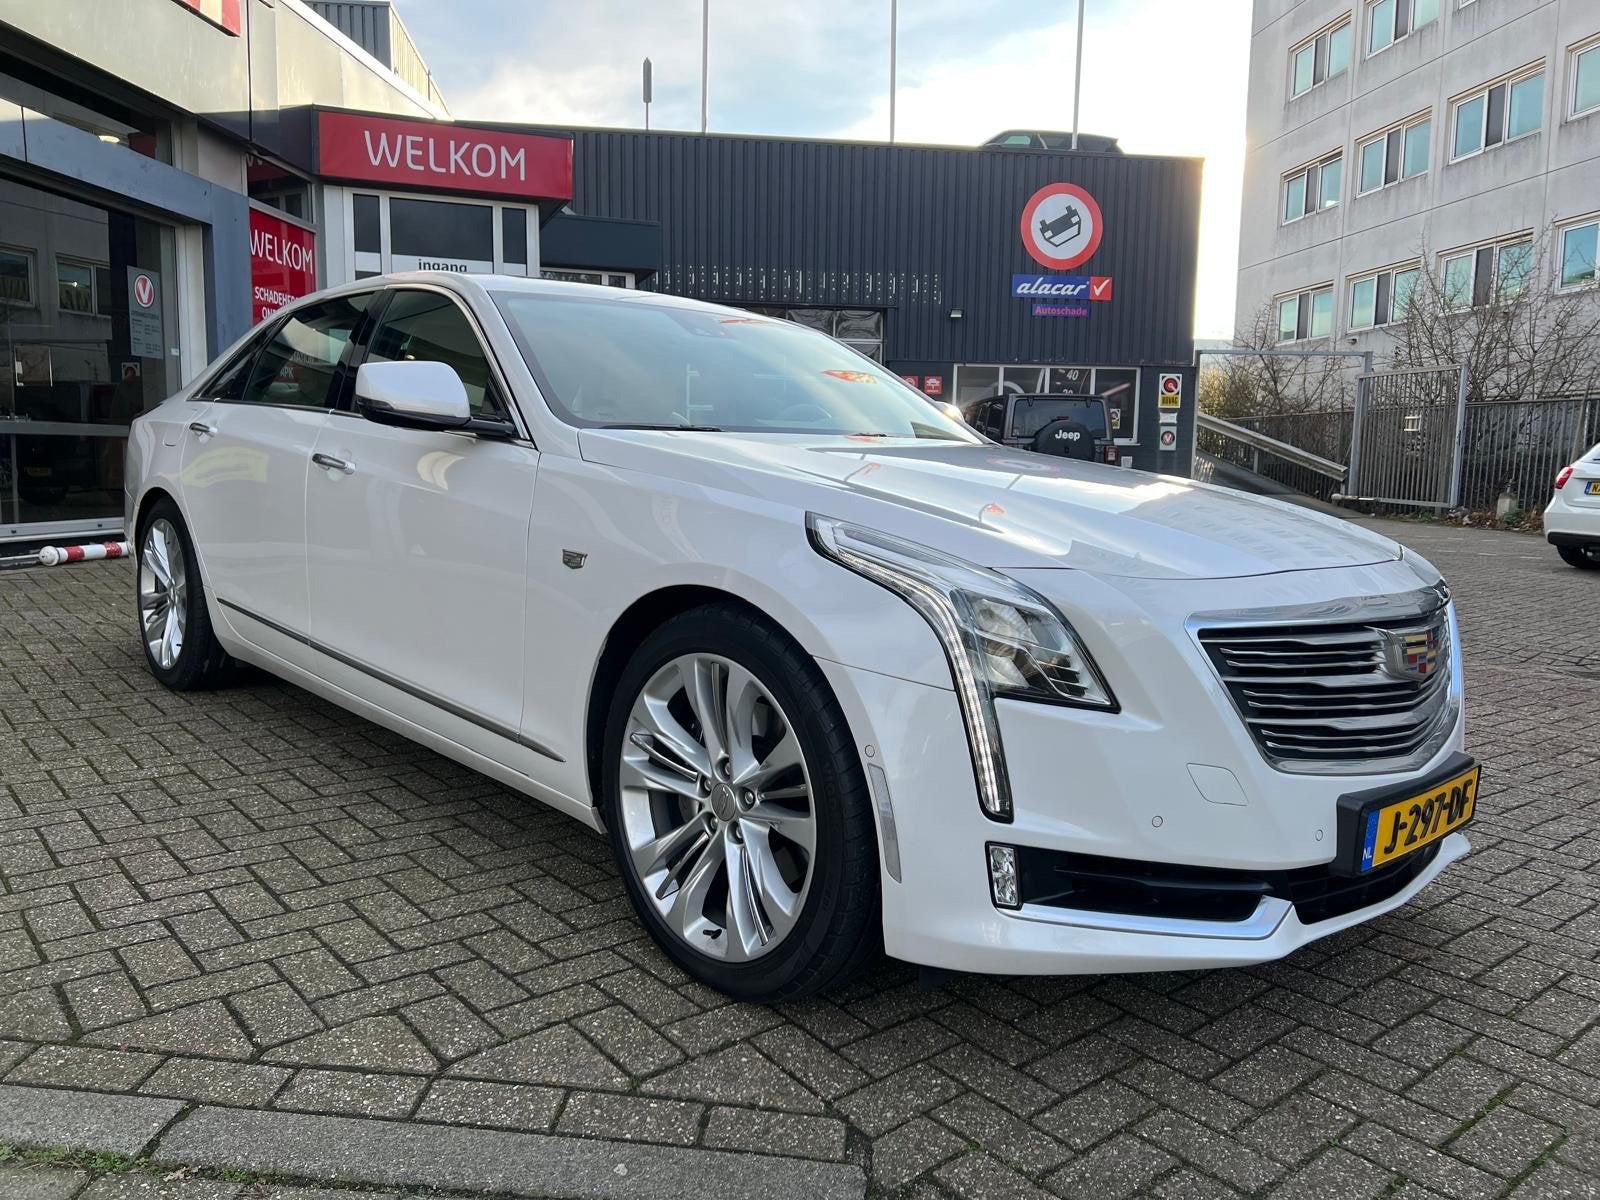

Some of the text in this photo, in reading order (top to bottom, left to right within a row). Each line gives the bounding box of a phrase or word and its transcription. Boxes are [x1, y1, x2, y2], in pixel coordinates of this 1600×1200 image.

[364, 130, 526, 181] WELKOM
[249, 227, 313, 275] WELKOM
[418, 258, 467, 272] ingang
[1016, 276, 1087, 296] alacar
[254, 286, 298, 306] SCHADEHE
[261, 306, 276, 320] ON
[1035, 305, 1088, 316] Autoschade
[1066, 369, 1079, 381] 40
[1054, 429, 1081, 441] Jeep
[1383, 778, 1473, 855] J-297-DF
[1362, 847, 1372, 861] NL
